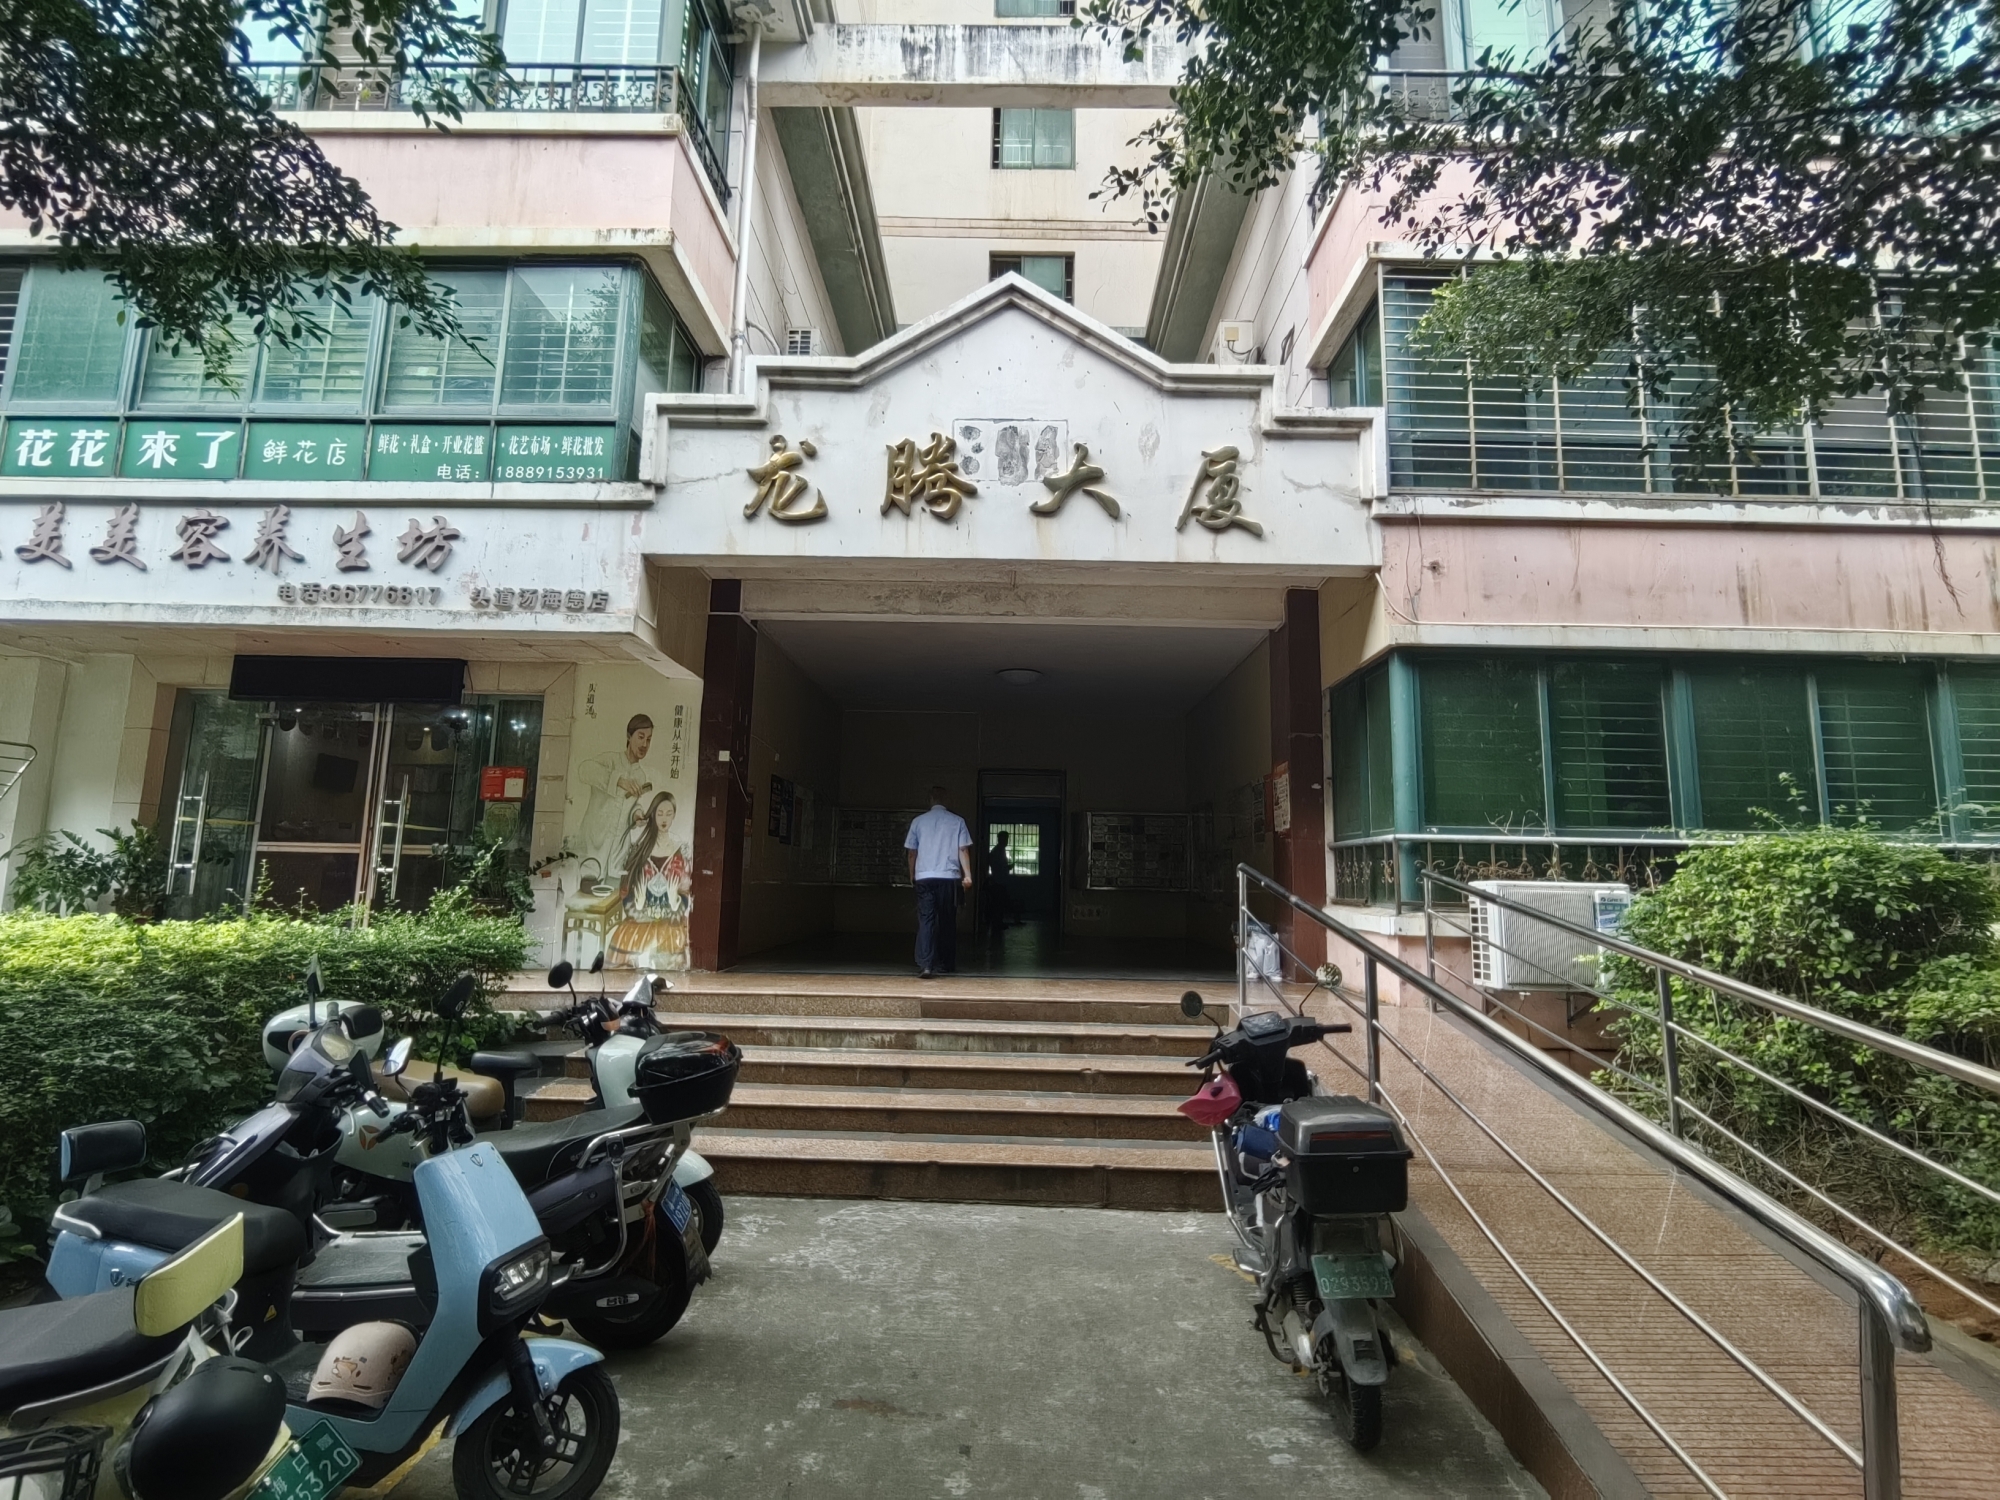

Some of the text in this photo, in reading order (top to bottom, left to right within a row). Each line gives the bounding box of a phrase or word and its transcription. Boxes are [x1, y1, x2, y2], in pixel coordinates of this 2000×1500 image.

[263, 437, 348, 465] 鲜花店
[496, 465, 604, 479] 18889153931
[670, 704, 684, 780] 健康从头开始
[287, 1447, 352, 1500] 5320
